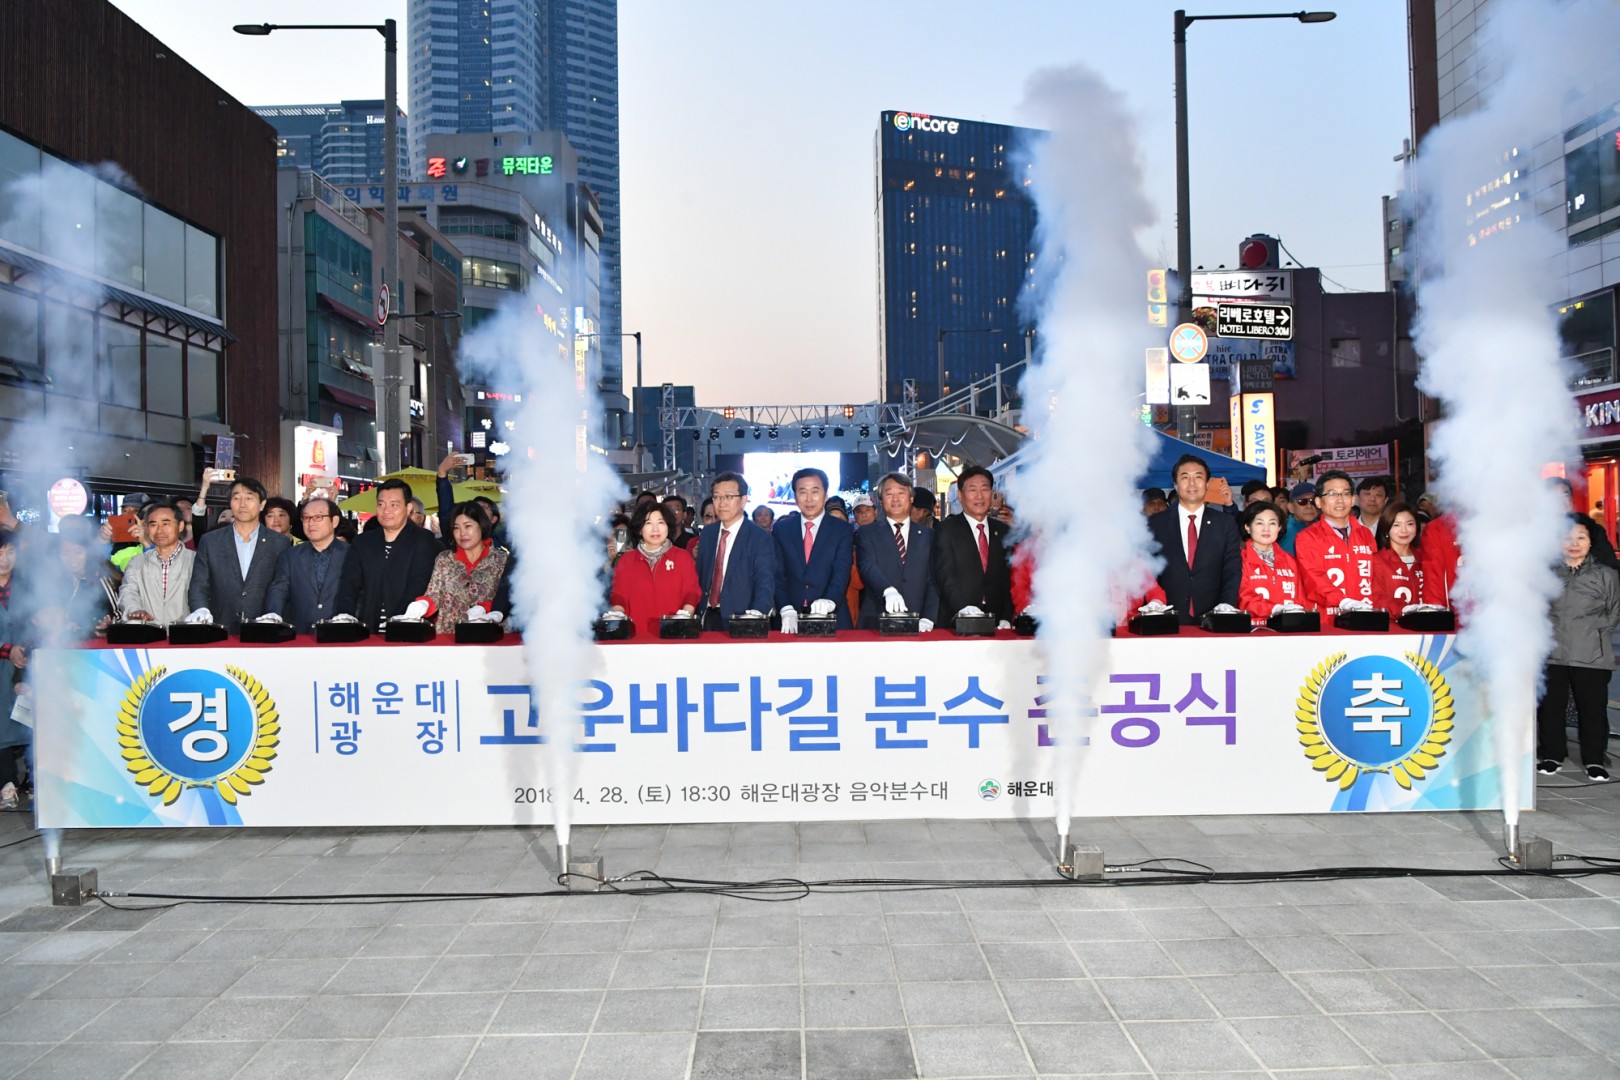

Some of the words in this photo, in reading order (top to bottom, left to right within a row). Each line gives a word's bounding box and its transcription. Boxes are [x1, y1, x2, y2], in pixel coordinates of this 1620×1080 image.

[895, 112, 959, 134] encore
[502, 156, 553, 175] 뮤직타운
[322, 184, 458, 204] 의학과의원
[1219, 306, 1275, 325] 리베로호텔
[1219, 323, 1245, 334] HOTEL
[1246, 325, 1274, 335] LIBERO
[1274, 326, 1290, 336] 30M
[1206, 354, 1226, 365] TRA
[1265, 346, 1288, 354] EXTRA
[1254, 424, 1265, 454] SAVE
[479, 675, 841, 752] 고운바다길
[865, 675, 1010, 749] 분수
[1344, 672, 1410, 746] 축
[168, 687, 230, 762] 경
[573, 787, 590, 804] 4.
[599, 786, 628, 804] 28.
[637, 784, 672, 804] (토)
[680, 785, 731, 802] 18:30
[740, 782, 841, 802] 해운대광장
[849, 780, 948, 801] 음악분수대
[1007, 780, 1057, 797] 해운대
